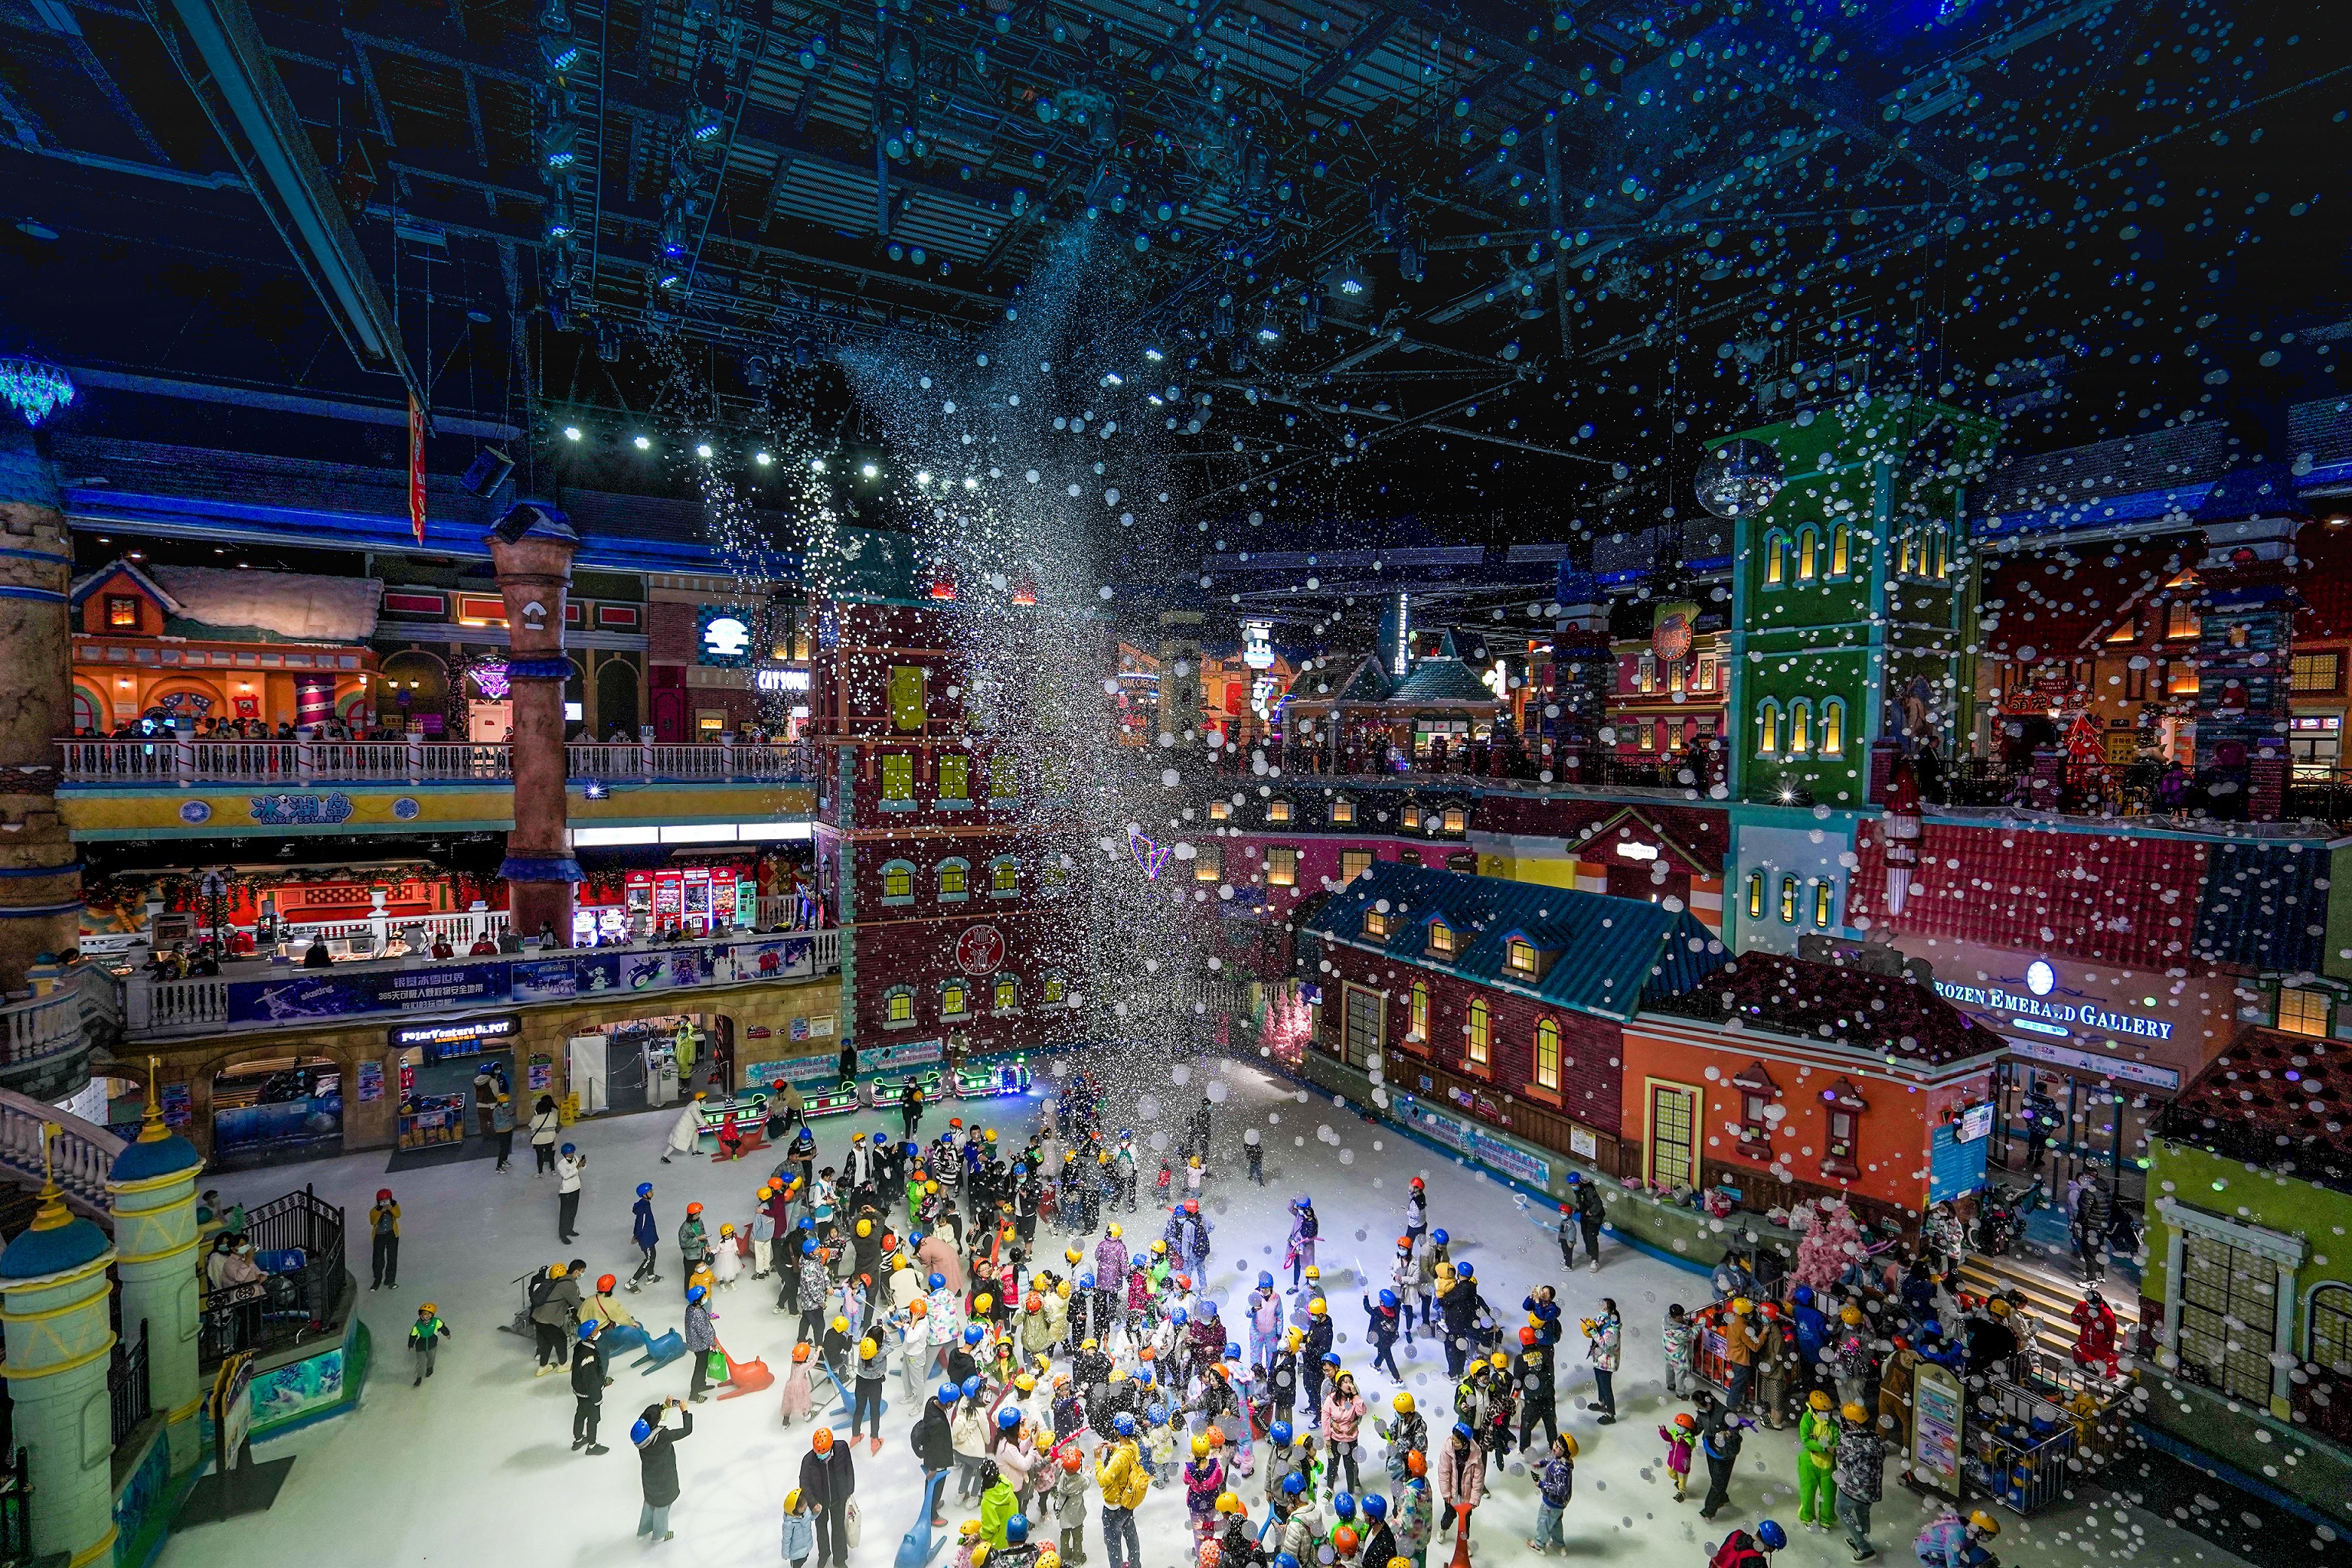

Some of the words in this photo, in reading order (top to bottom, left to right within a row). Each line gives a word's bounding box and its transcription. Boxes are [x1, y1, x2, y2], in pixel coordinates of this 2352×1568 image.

[1659, 630, 1684, 640] FAST
[1658, 639, 1685, 648] FOOD
[250, 792, 352, 819] 冰湖岛
[968, 927, 993, 937] FORD
[963, 959, 998, 972] MUSTANG
[394, 972, 465, 988] 银基冰雪世界
[300, 985, 334, 1001] skating
[378, 984, 484, 1001] 365天可吸入颗粒物安全地带
[1935, 982, 1986, 1005] ROZEN
[2079, 1004, 2172, 1040] GALLERY
[475, 1022, 509, 1034] DEPOT
